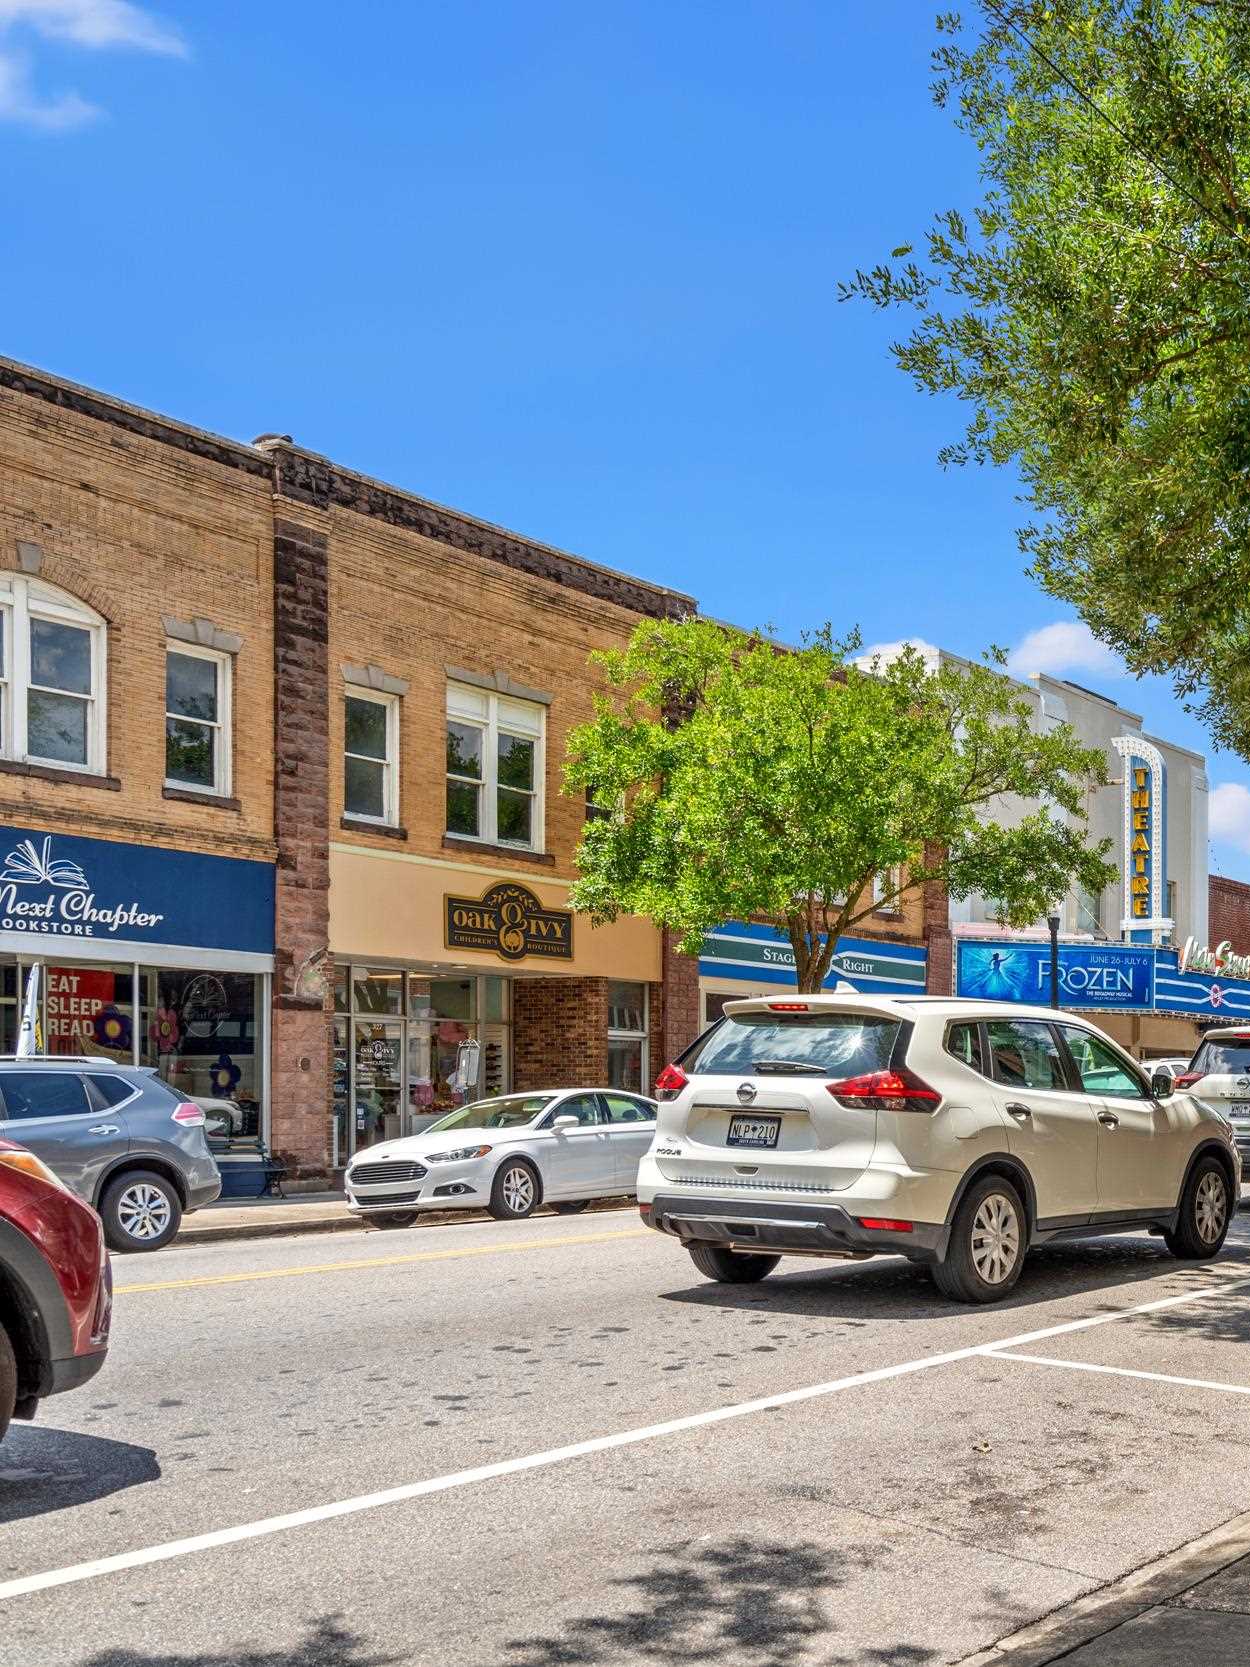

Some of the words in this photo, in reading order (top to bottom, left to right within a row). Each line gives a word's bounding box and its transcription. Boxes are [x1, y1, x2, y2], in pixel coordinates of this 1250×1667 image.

[1131, 768, 1149, 916] THEATRE
[0, 883, 55, 918] Next
[60, 890, 164, 932] Chapter
[1, 917, 94, 936] OOKSTORE
[528, 919, 567, 938] IVY
[527, 943, 567, 953] BOUTIQUE
[842, 960, 876, 974] RIGHT
[1089, 956, 1110, 965] JUNE
[48, 975, 81, 993] EAT
[1038, 960, 1134, 995] FROZEN
[48, 996, 103, 1016] SLEEP
[48, 1018, 96, 1037] READ
[732, 1124, 751, 1138] NLP
[757, 1125, 776, 1139] 210
